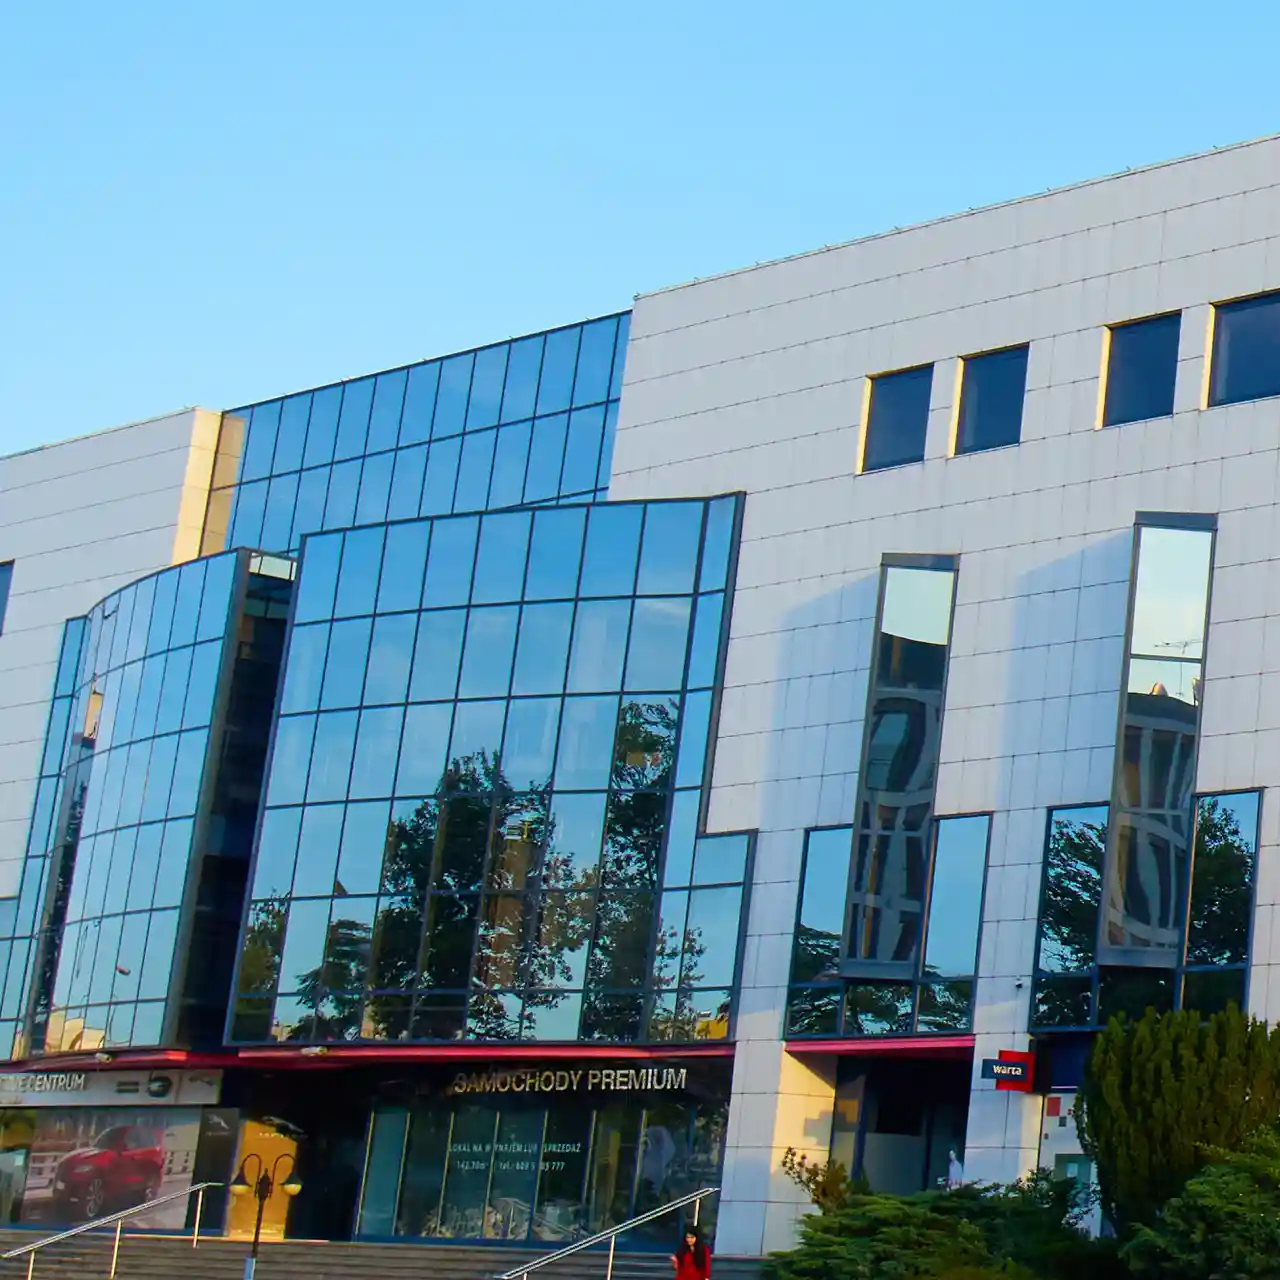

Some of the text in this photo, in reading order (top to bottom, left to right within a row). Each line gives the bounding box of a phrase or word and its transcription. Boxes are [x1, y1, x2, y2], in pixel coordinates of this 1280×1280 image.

[993, 1064, 1022, 1076] warta
[453, 1068, 687, 1093] SAMOCHODY PREMIUM
